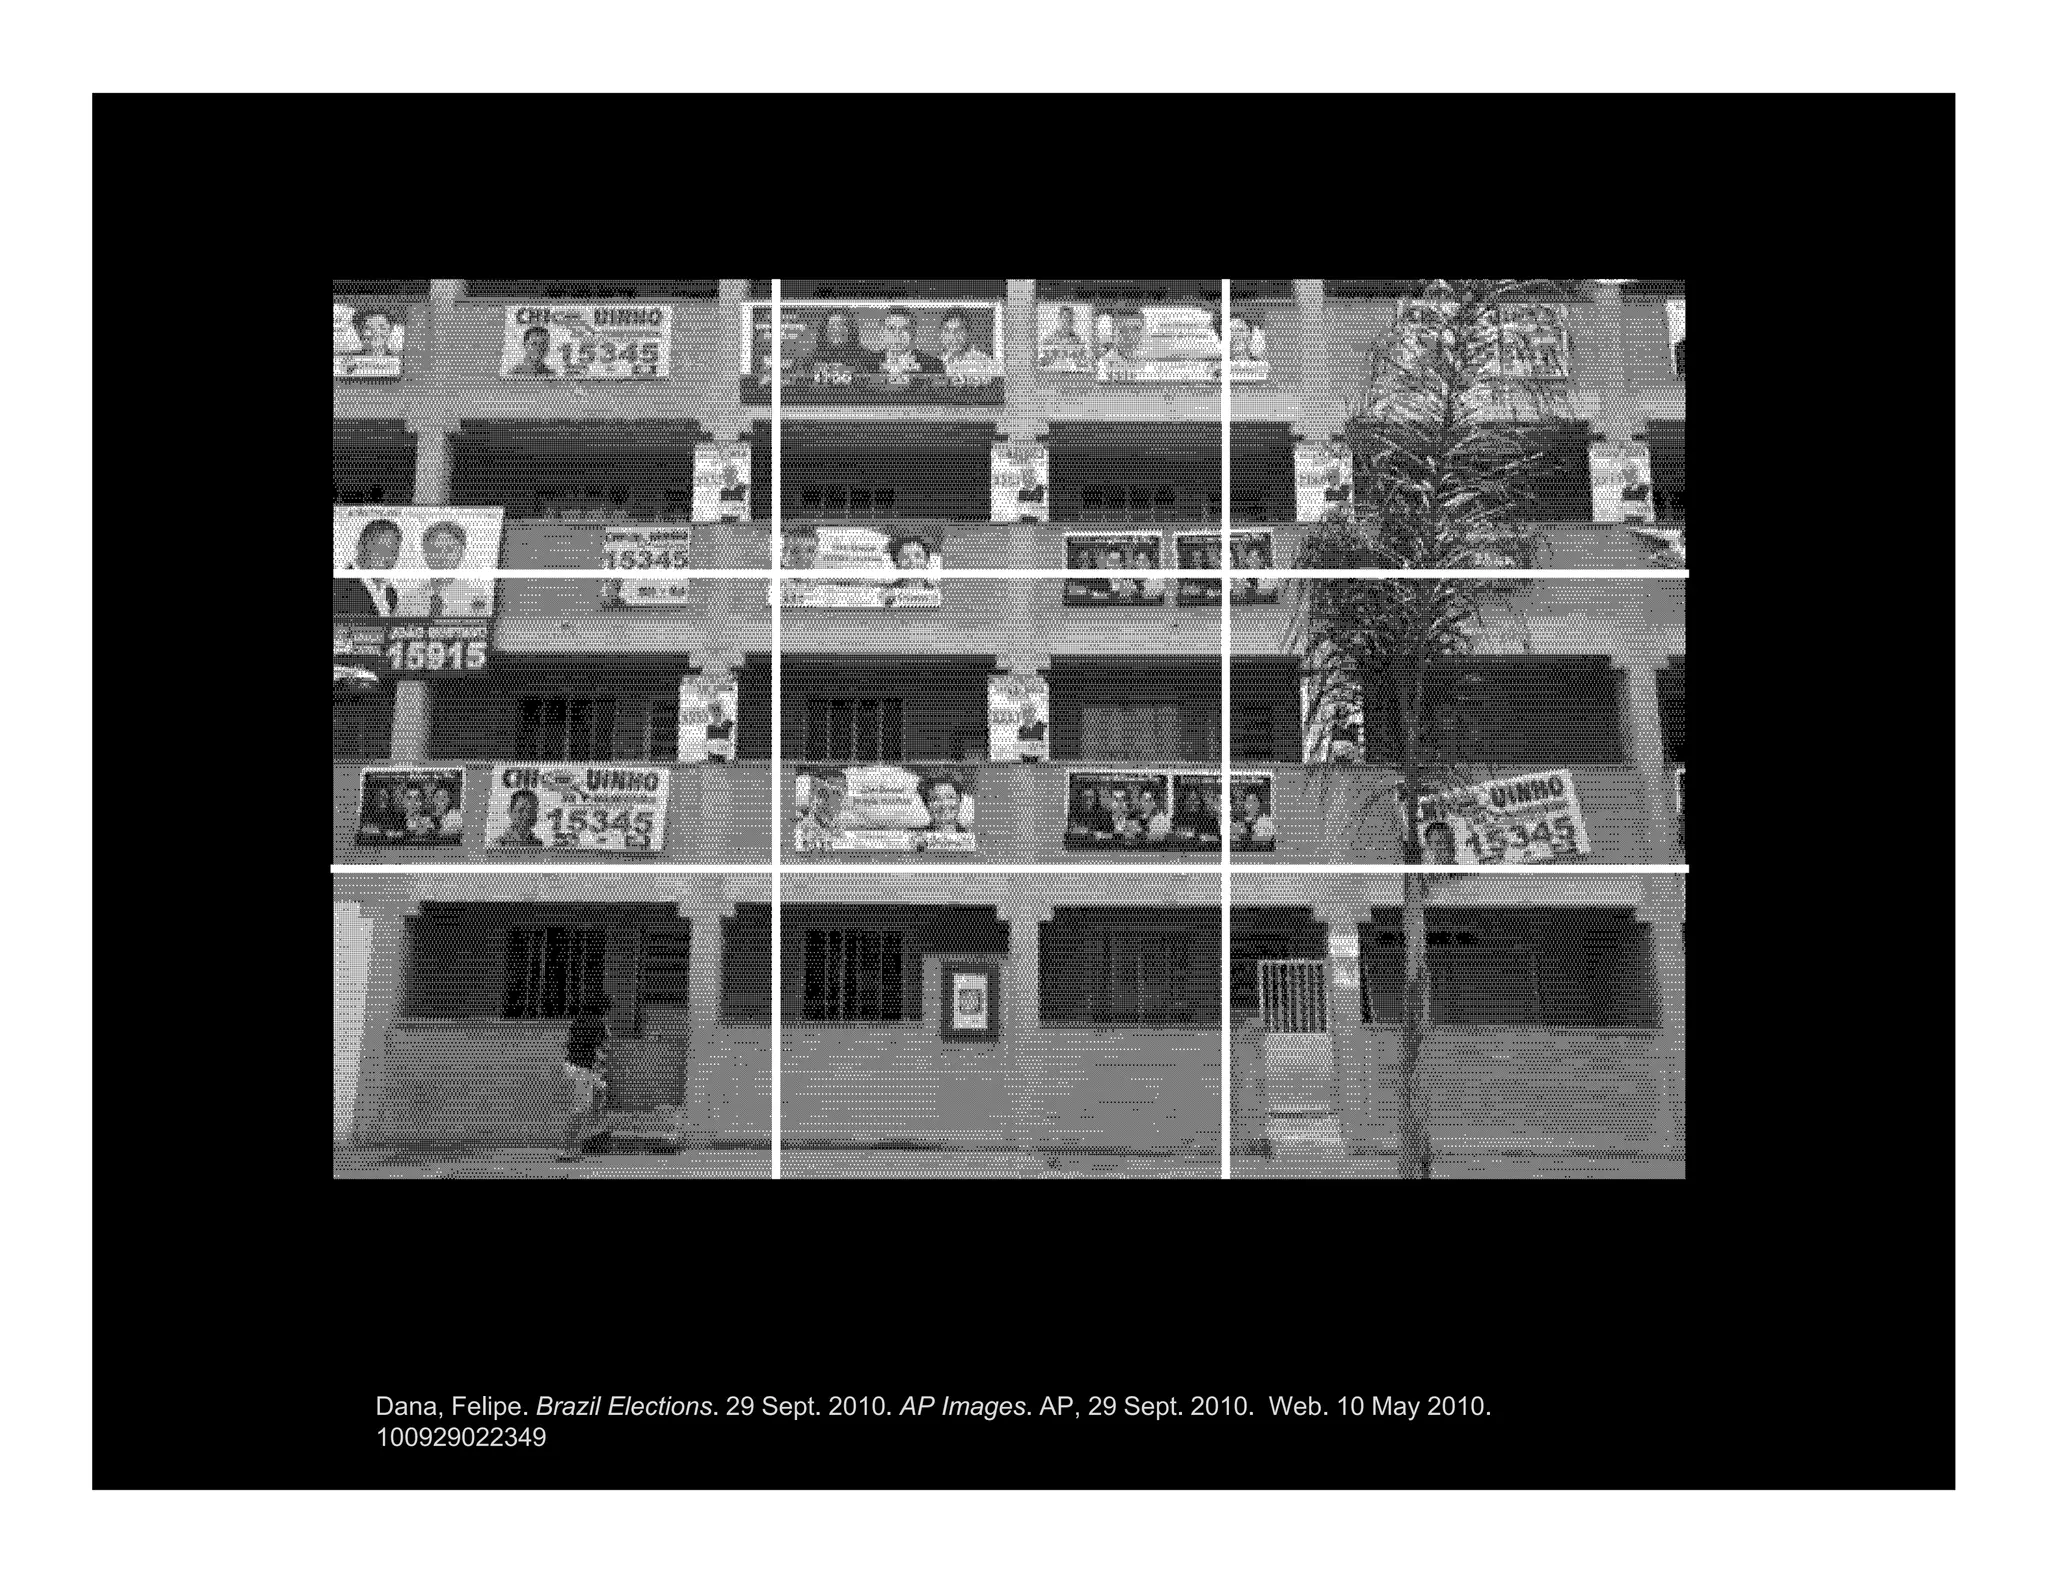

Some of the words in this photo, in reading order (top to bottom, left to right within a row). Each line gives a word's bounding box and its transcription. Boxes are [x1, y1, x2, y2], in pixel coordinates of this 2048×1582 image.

[558, 342, 659, 364] 15345
[601, 550, 689, 570] 15345
[387, 641, 487, 670] 15915
[547, 808, 653, 834] 15345
[1466, 816, 1576, 856] 15345
